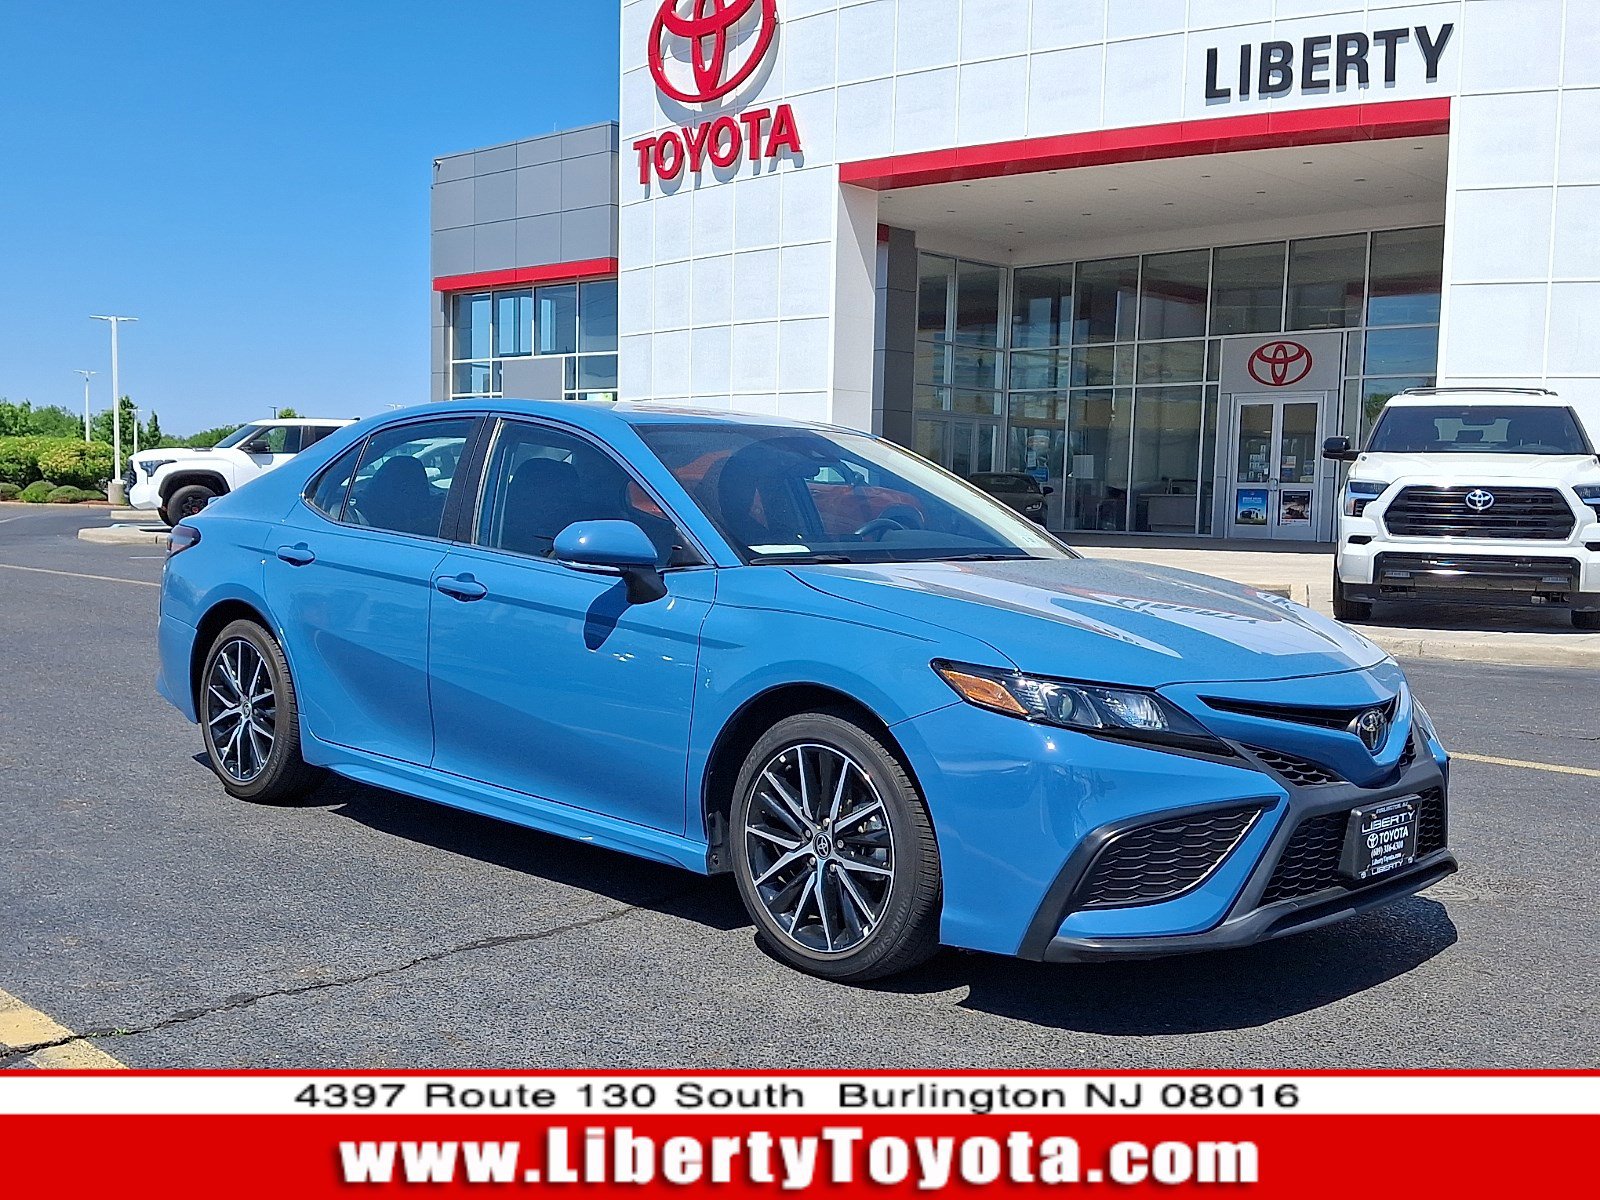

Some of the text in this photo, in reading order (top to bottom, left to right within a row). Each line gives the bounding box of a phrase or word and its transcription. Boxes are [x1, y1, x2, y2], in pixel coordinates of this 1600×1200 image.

[1205, 23, 1455, 99] LIBERTY
[633, 104, 803, 185] TOYOTA
[1361, 810, 1415, 833] LIBERTY
[1379, 826, 1409, 844] TOYOTA
[1371, 858, 1404, 875] LIBERTY
